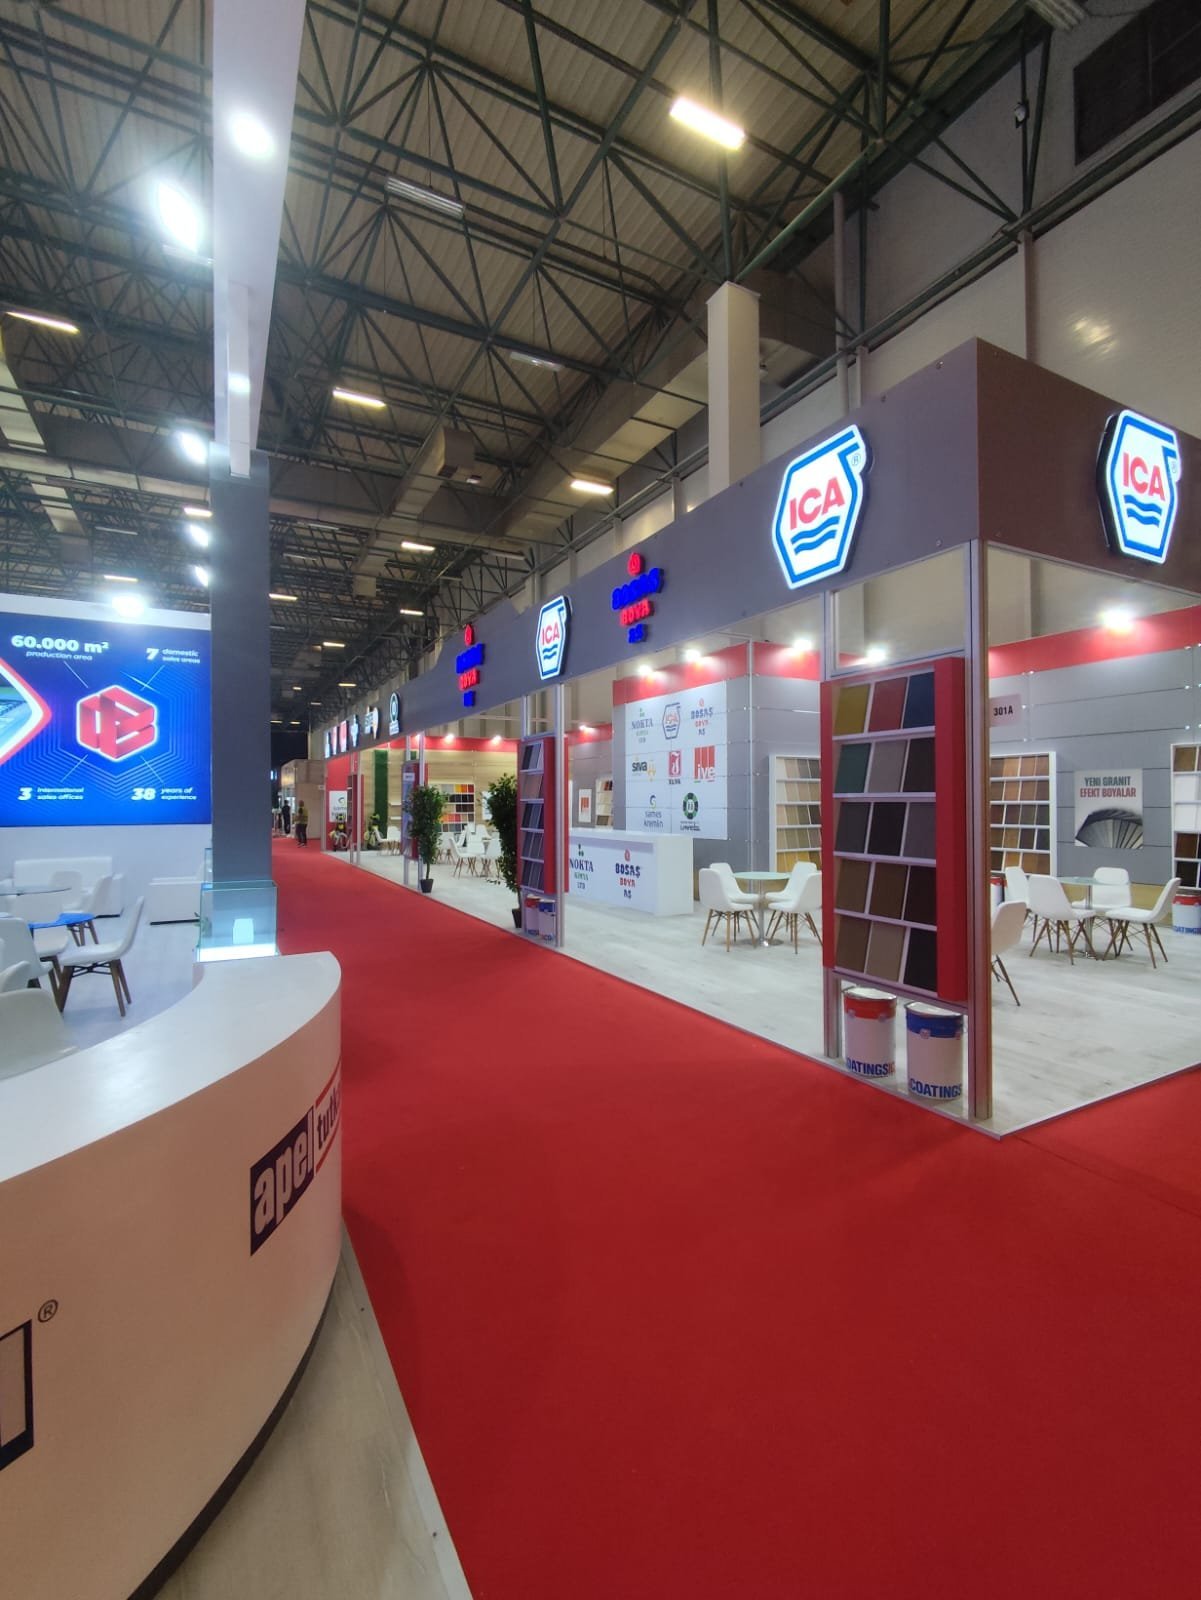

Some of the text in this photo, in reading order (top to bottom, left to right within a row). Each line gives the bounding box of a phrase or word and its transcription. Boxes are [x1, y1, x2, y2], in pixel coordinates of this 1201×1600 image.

[1122, 451, 1166, 503] ICA
[789, 477, 846, 531] ICA
[541, 622, 560, 646] ICA
[11, 635, 79, 651] 60.000
[26, 650, 72, 660] production
[146, 648, 159, 660] 7
[993, 705, 1013, 716] 301A
[18, 787, 32, 801] 3
[1080, 787, 1136, 798] EFEKT BOYALAR
[569, 858, 594, 873] NOKTA
[253, 1106, 313, 1236] apel
